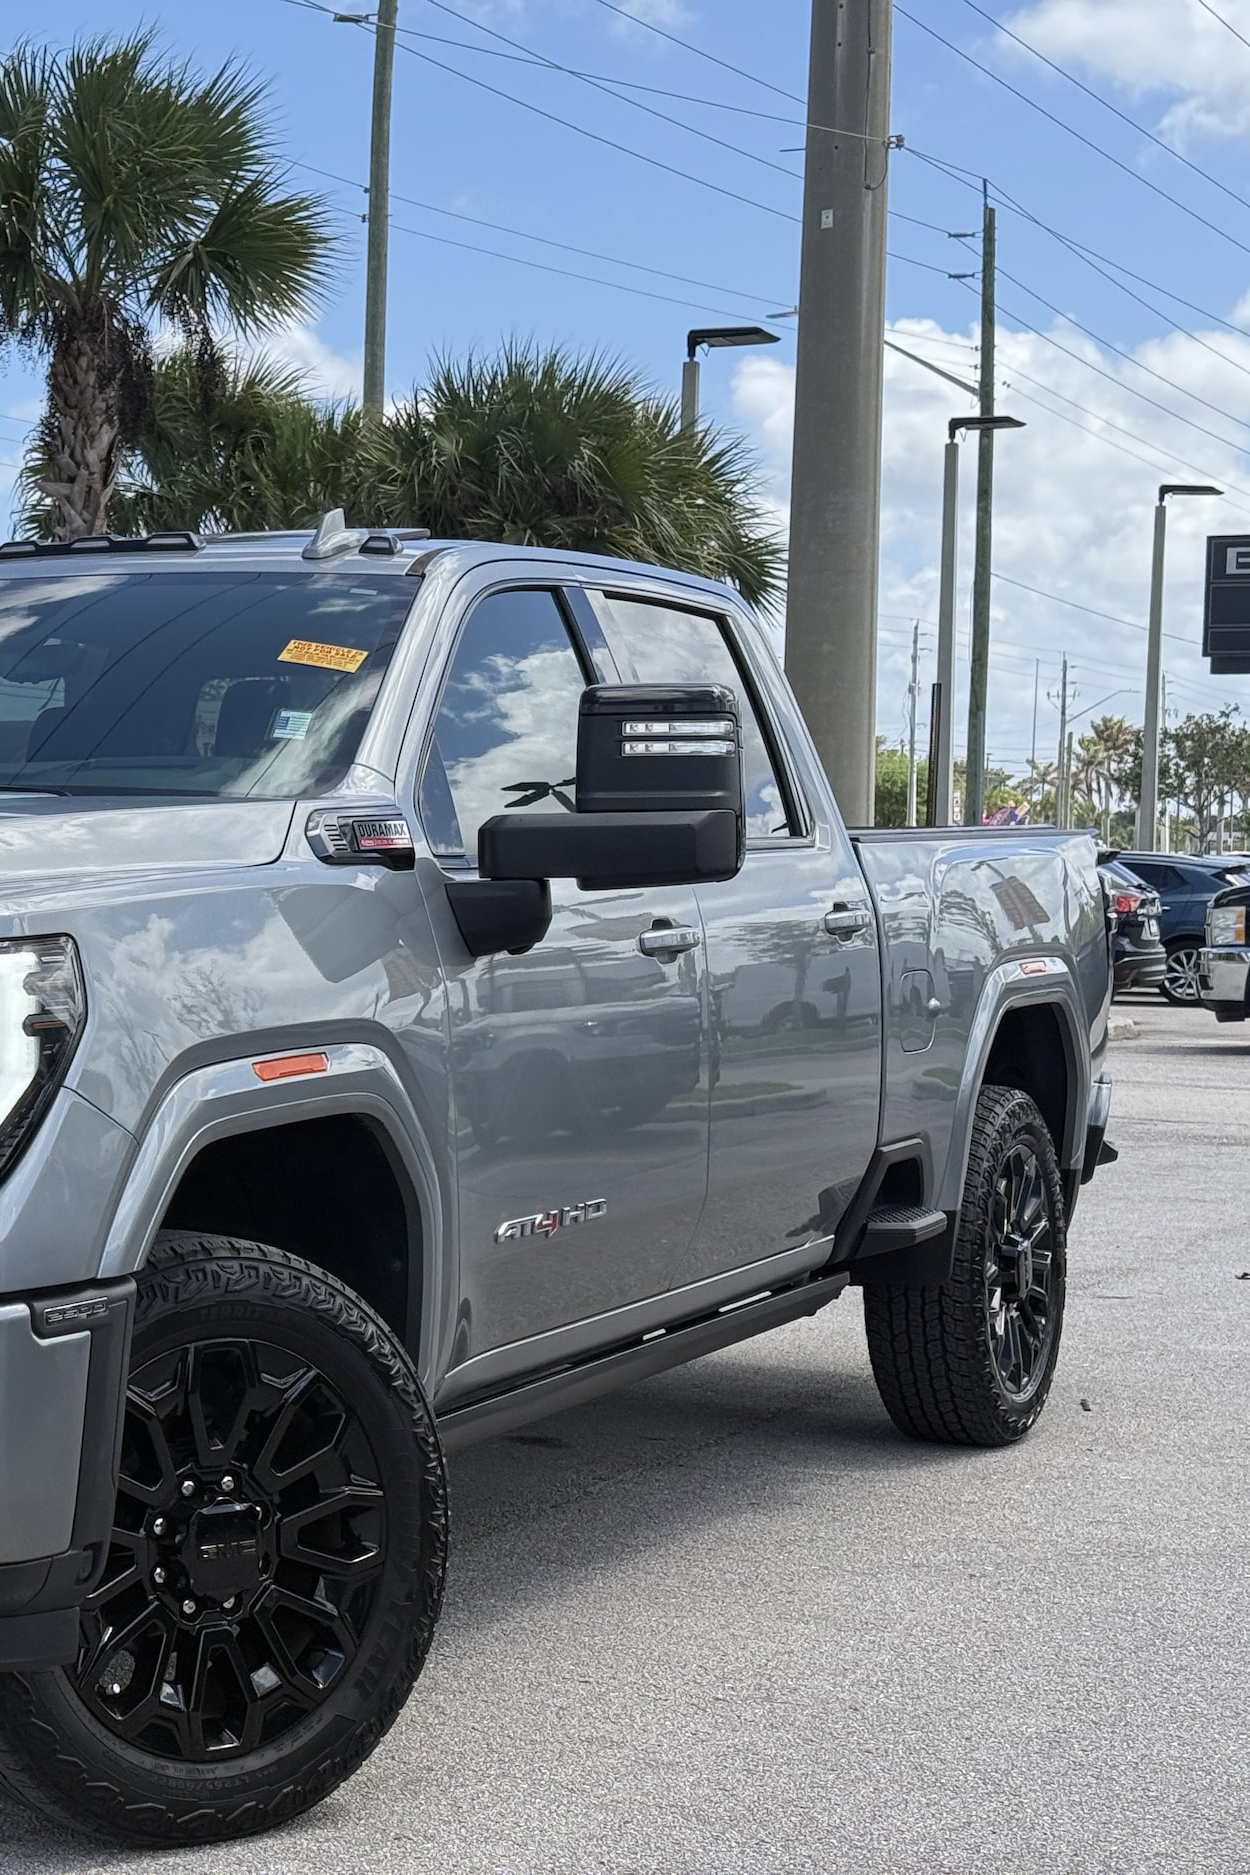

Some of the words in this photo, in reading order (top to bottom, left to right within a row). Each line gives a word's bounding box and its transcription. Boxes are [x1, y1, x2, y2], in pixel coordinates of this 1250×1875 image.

[315, 644, 352, 653] VEHICLE
[357, 823, 407, 837] DURAMAX
[494, 1210, 559, 1243] AT4
[561, 1198, 607, 1227] HD
